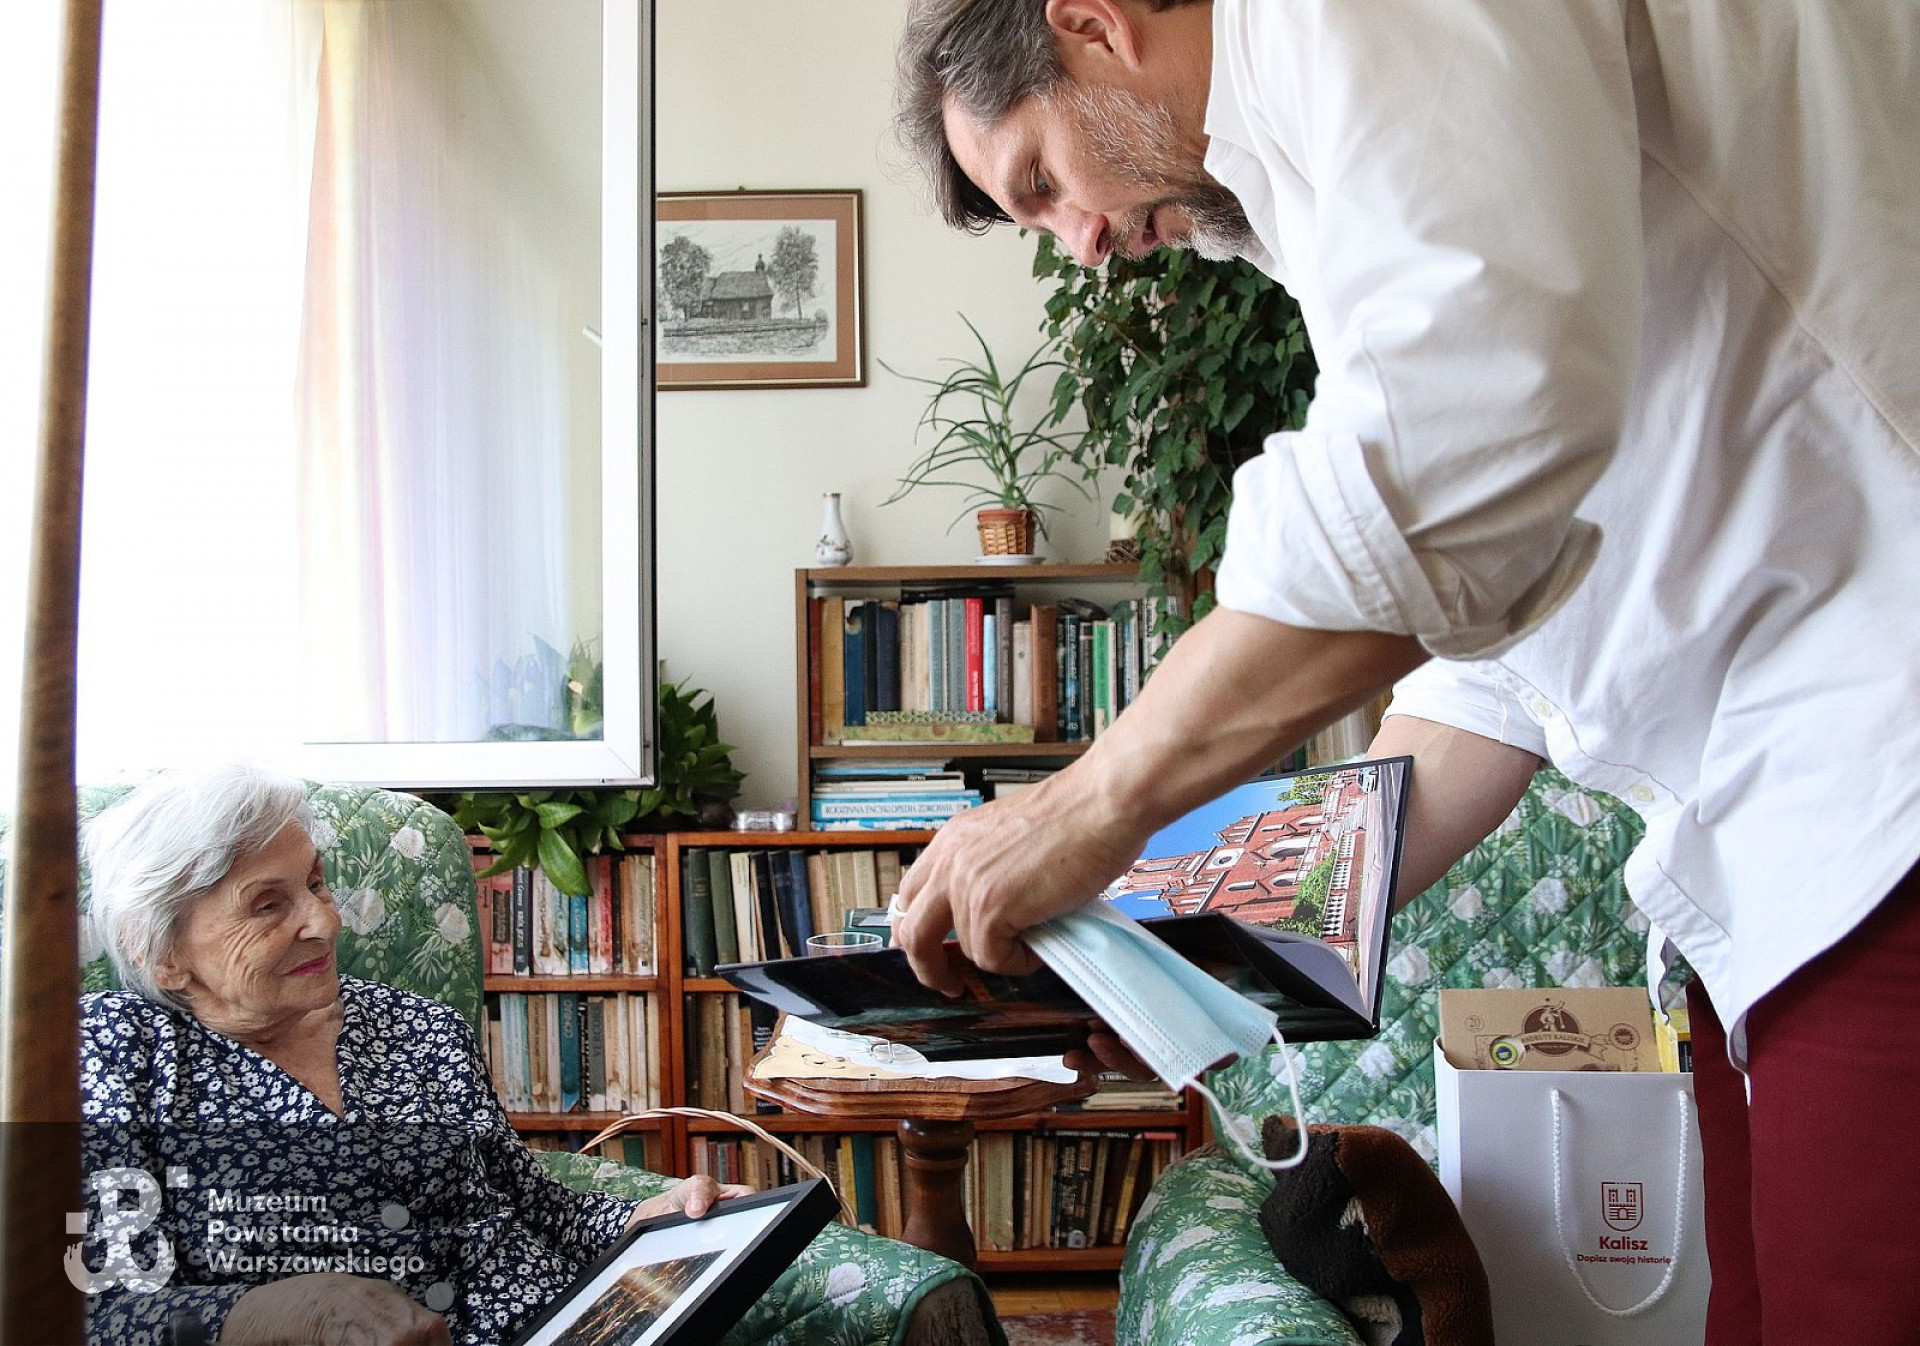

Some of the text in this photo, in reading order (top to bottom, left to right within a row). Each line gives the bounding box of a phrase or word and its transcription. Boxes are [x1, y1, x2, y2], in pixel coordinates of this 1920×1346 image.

[1599, 1236, 1648, 1251] Kalisz
[1576, 1254, 1607, 1264] Dopisz
[1609, 1255, 1636, 1265] swoją
